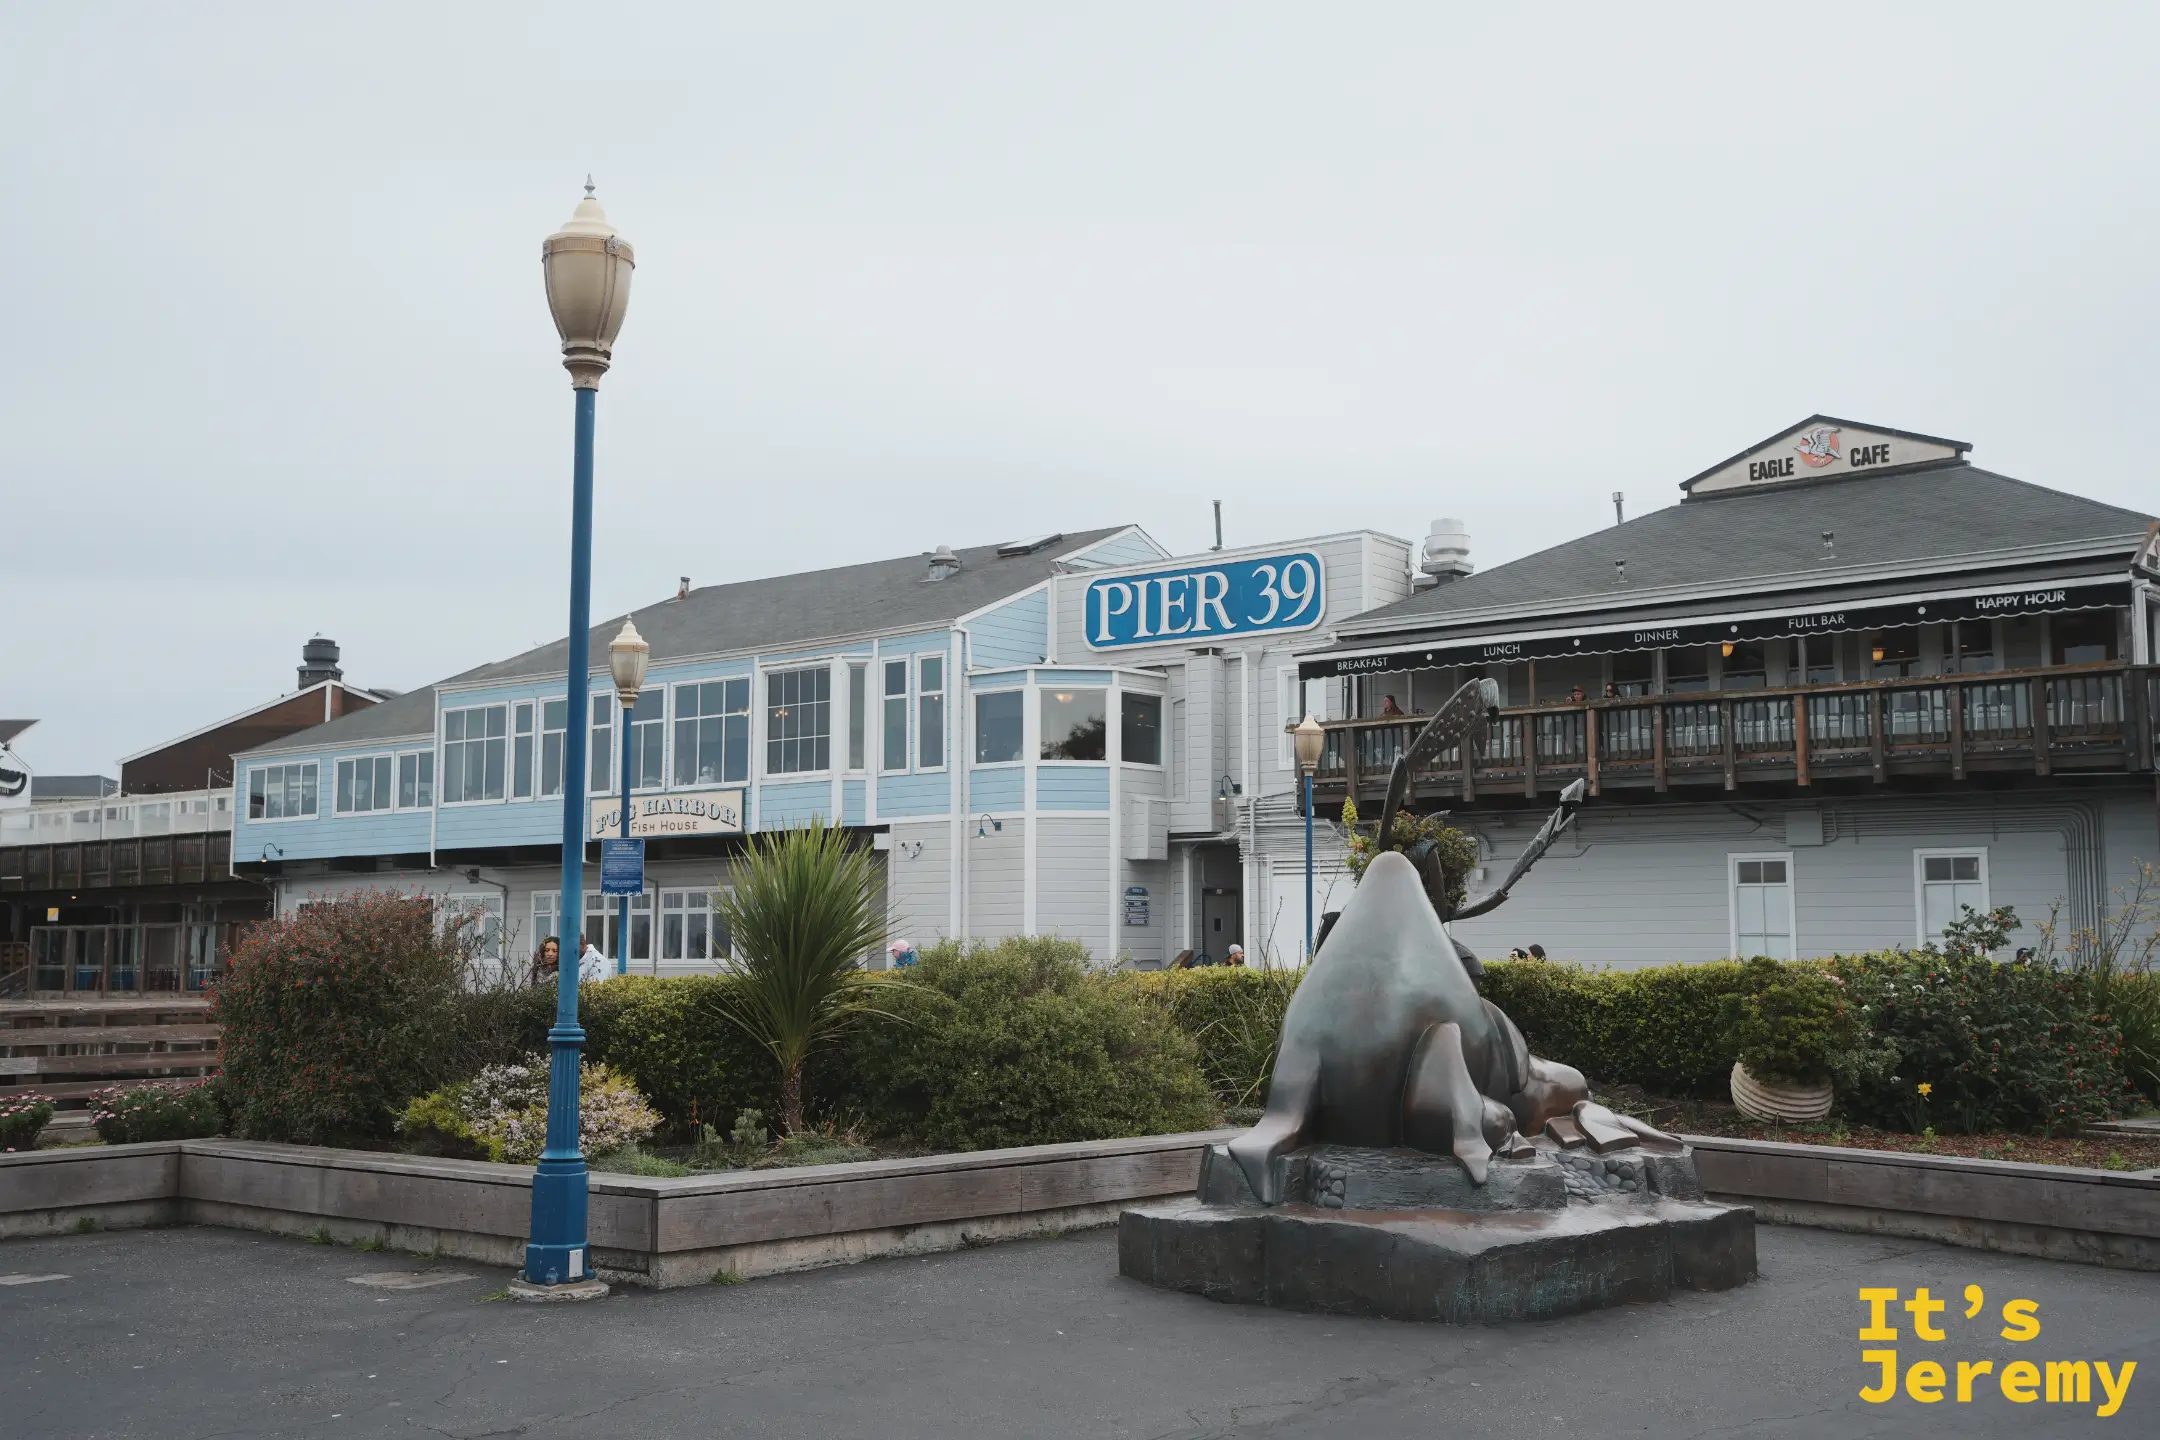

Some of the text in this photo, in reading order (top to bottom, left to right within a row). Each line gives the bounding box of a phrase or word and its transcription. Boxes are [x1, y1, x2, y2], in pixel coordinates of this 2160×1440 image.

[1749, 444, 1890, 482] EAGLE CAFE
[1092, 559, 1316, 642] PIER 39
[1975, 590, 2066, 609] HAPPY HOUR
[1788, 613, 1846, 629] FULL BAR
[1634, 629, 1680, 643] DINNER
[1483, 644, 1521, 657] LUNCH
[1337, 657, 1388, 671] BREAKFAST
[642, 798, 737, 827] HARBOR
